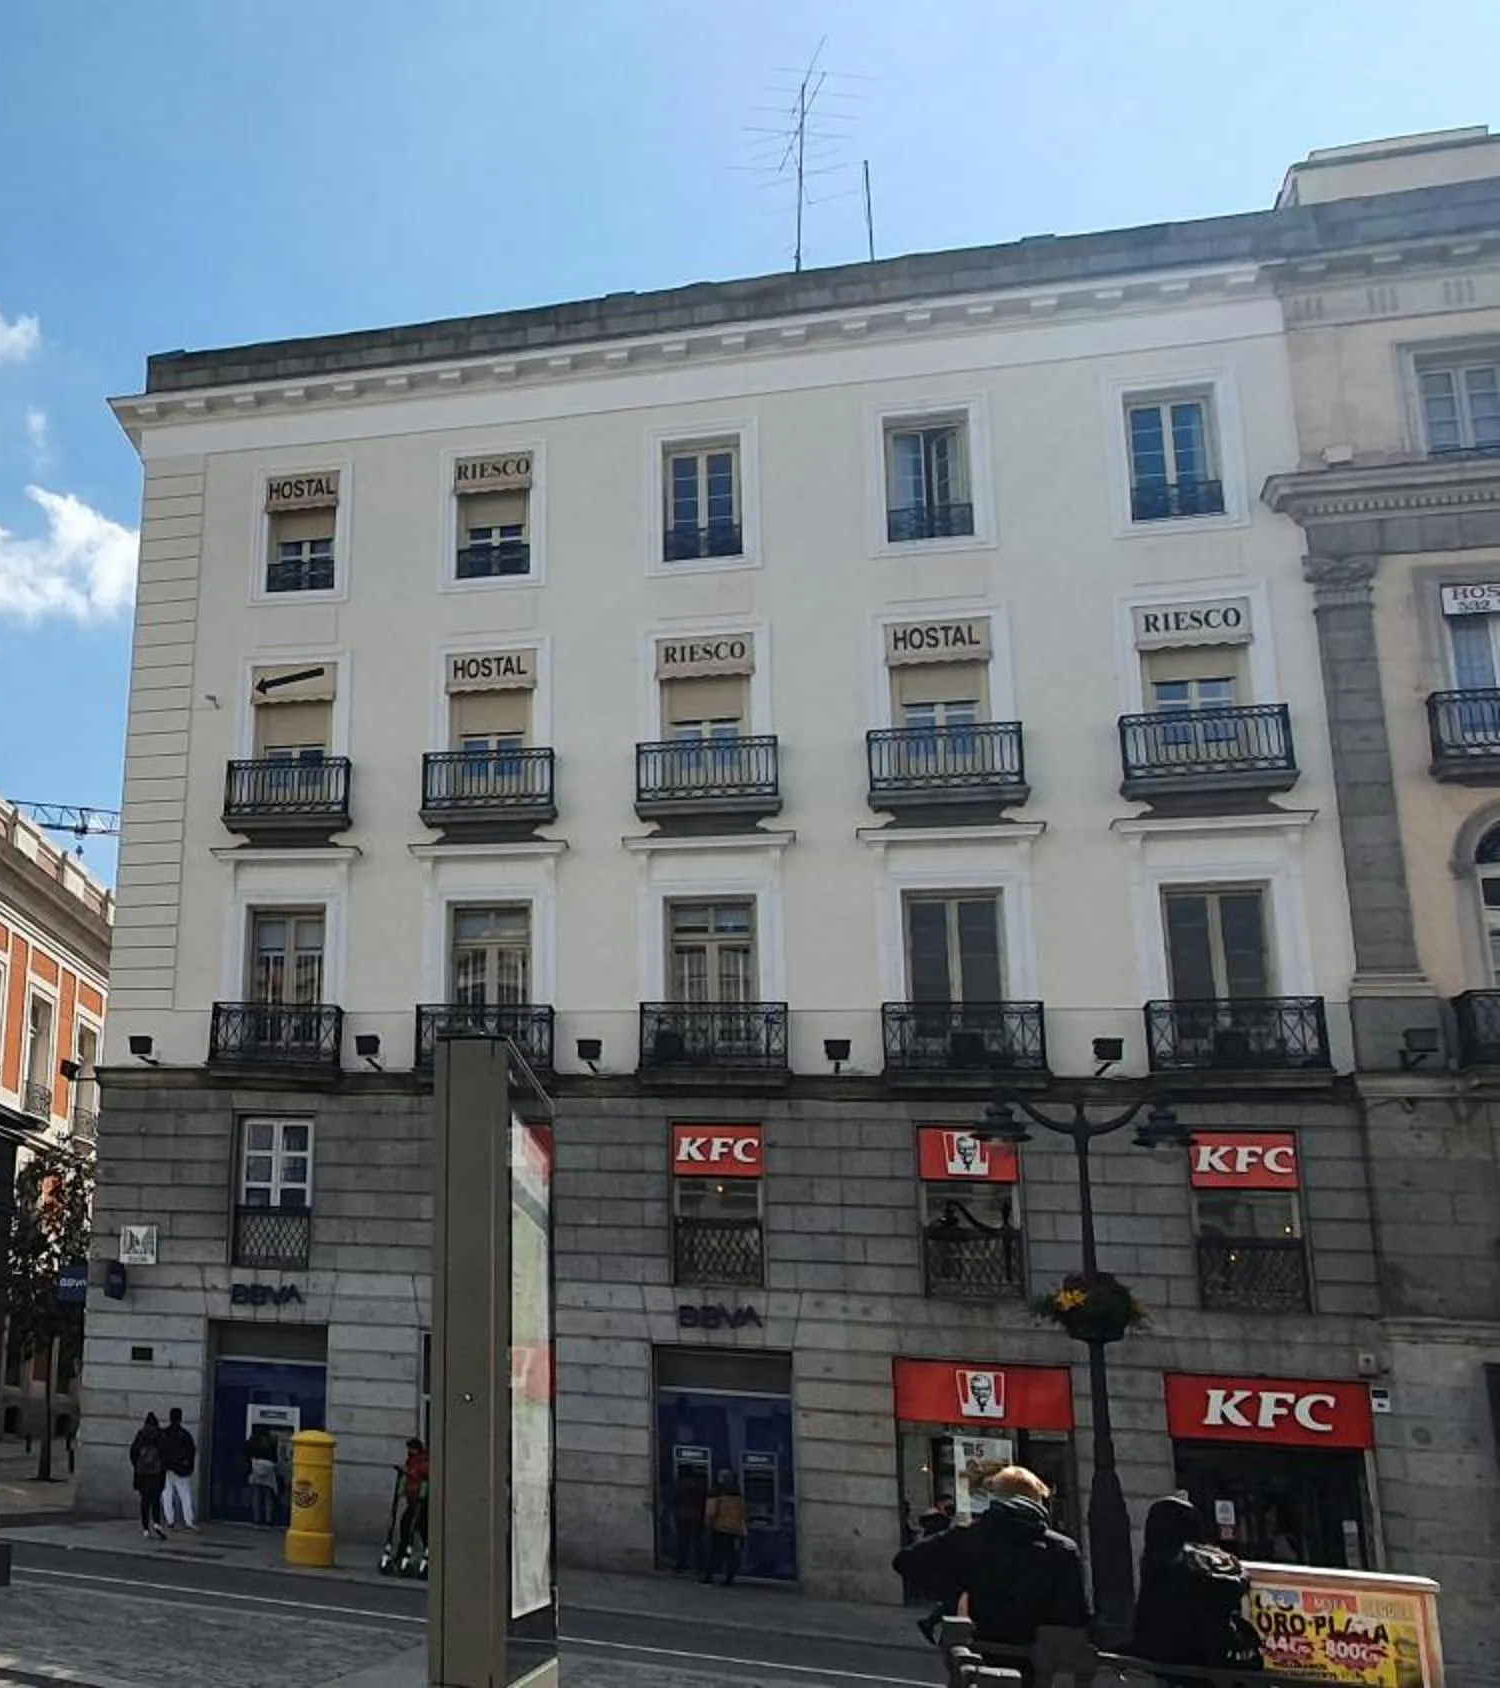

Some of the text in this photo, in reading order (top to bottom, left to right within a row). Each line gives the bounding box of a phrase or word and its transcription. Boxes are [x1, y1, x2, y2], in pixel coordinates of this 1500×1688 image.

[456, 456, 532, 480] RIESCO
[268, 477, 337, 501] HOSTAL
[1143, 607, 1242, 634] RIESCO
[893, 624, 981, 651] HOSTAL
[663, 640, 746, 664] RIESCO
[452, 656, 528, 679] HOSTAL
[675, 1136, 759, 1164] KFC
[1196, 1145, 1295, 1174] KFC
[231, 1283, 306, 1306] BBVA
[678, 1303, 764, 1330] BBVA
[1203, 1388, 1337, 1432] KFC
